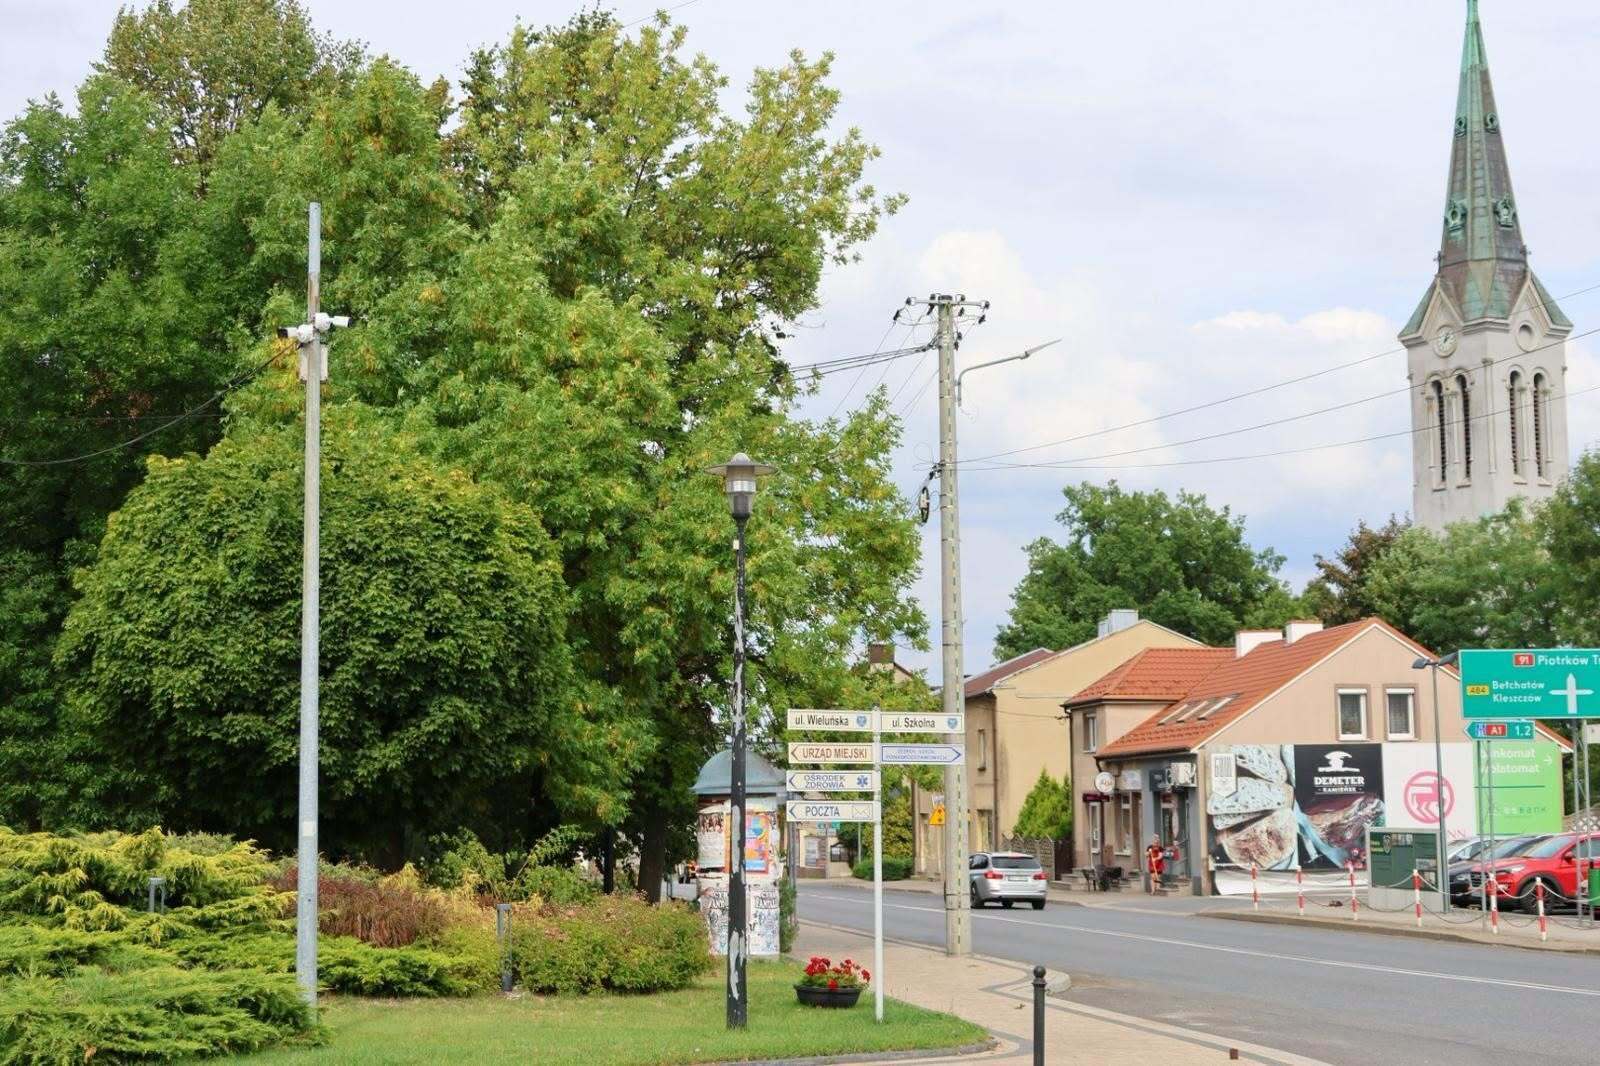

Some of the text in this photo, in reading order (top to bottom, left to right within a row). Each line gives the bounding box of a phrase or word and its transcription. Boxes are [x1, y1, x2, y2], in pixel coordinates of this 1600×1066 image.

[1519, 656, 1530, 665] 91
[1537, 654, 1589, 665] Piotrków
[795, 715, 849, 727] ul. Wieluńska
[892, 717, 936, 728] ul. Szkolna
[1490, 726, 1503, 735] A1
[802, 748, 867, 761] URZĄD MIEJSKI
[804, 774, 846, 782] OŚRODEK
[1313, 776, 1365, 785] DEMETER
[805, 781, 845, 789] ZDROWIA
[805, 806, 840, 817] POCZTA
